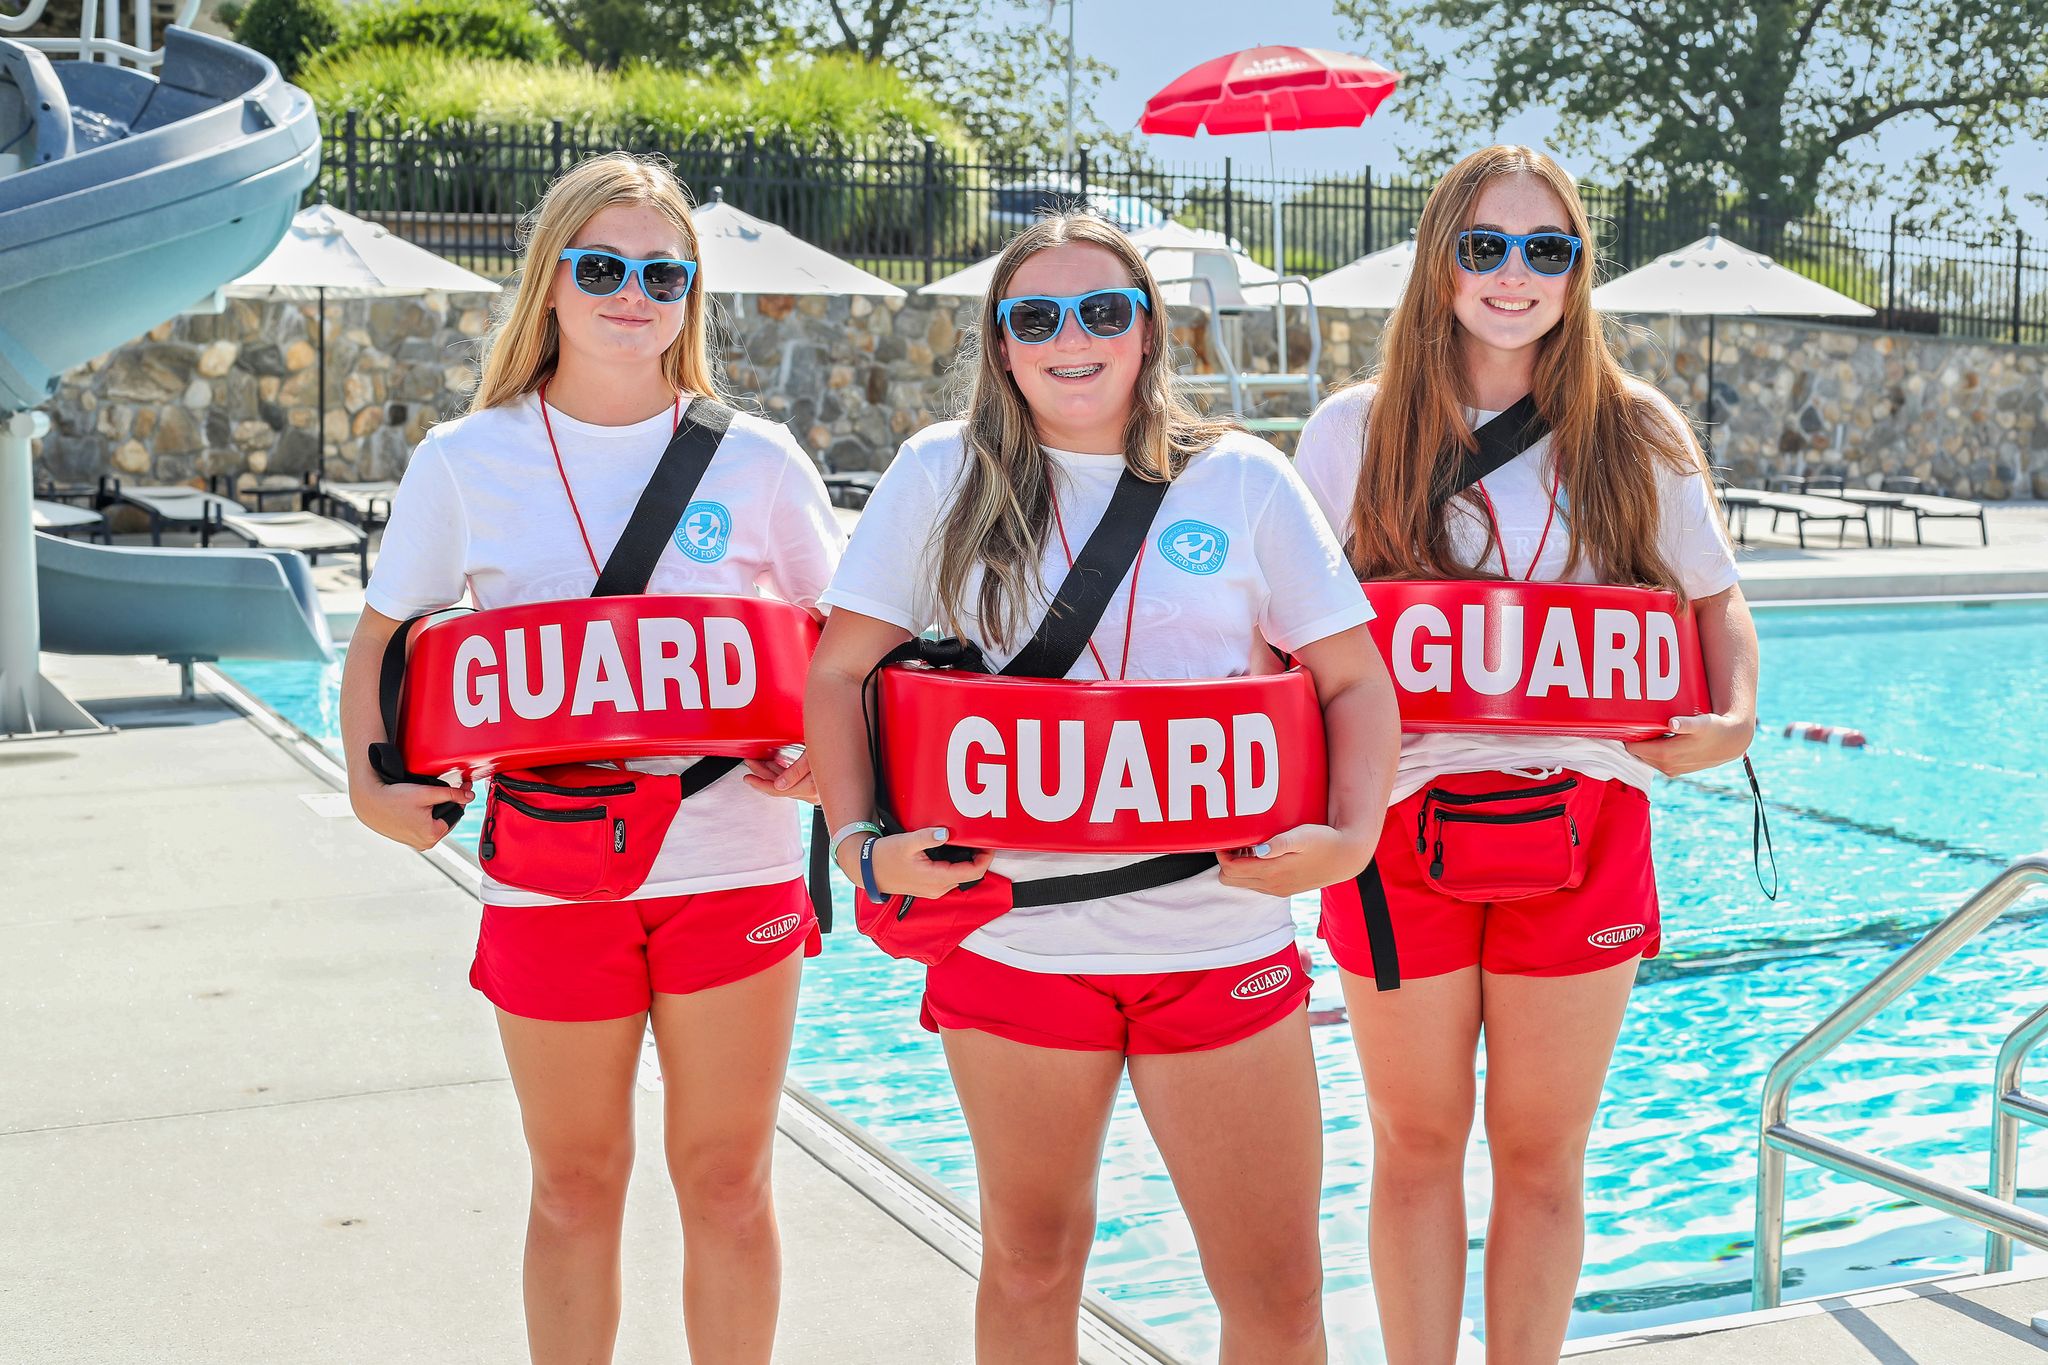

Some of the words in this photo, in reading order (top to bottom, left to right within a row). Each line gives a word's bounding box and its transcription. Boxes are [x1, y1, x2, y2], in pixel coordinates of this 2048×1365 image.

[677, 527, 699, 556] GUARD
[701, 550, 718, 558] FOR
[716, 534, 725, 552] LIFE
[1163, 545, 1189, 567] GUARD
[1191, 563, 1210, 572] FOR
[1209, 548, 1223, 568] LIFE
[1391, 603, 1680, 701] GUARD
[452, 616, 757, 728] GUARD
[946, 712, 1280, 823] GUARD
[763, 918, 793, 939] GUARD
[1604, 927, 1637, 944] GUARD
[1247, 969, 1285, 993] GUARD
